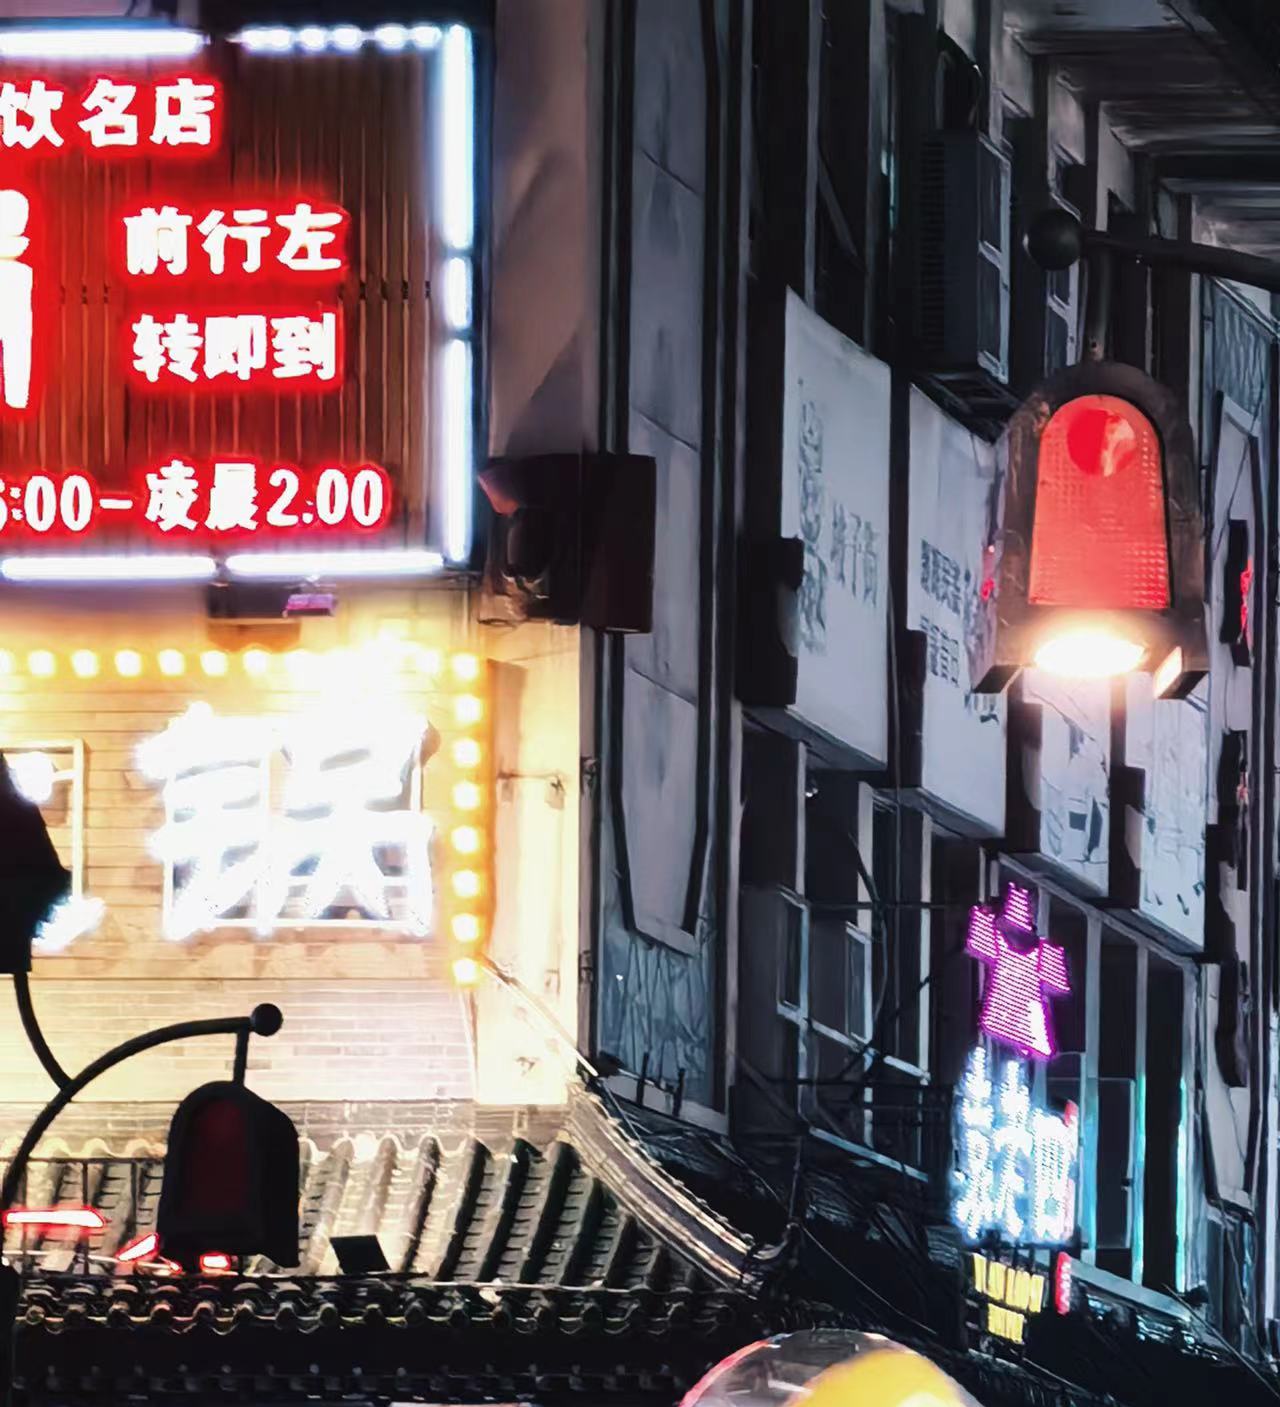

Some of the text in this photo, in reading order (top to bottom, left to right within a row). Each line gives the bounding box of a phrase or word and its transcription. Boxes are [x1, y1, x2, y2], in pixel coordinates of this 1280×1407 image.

[0, 78, 215, 149] 饮名店
[123, 203, 343, 276] 前行左
[131, 312, 336, 383] 转即到
